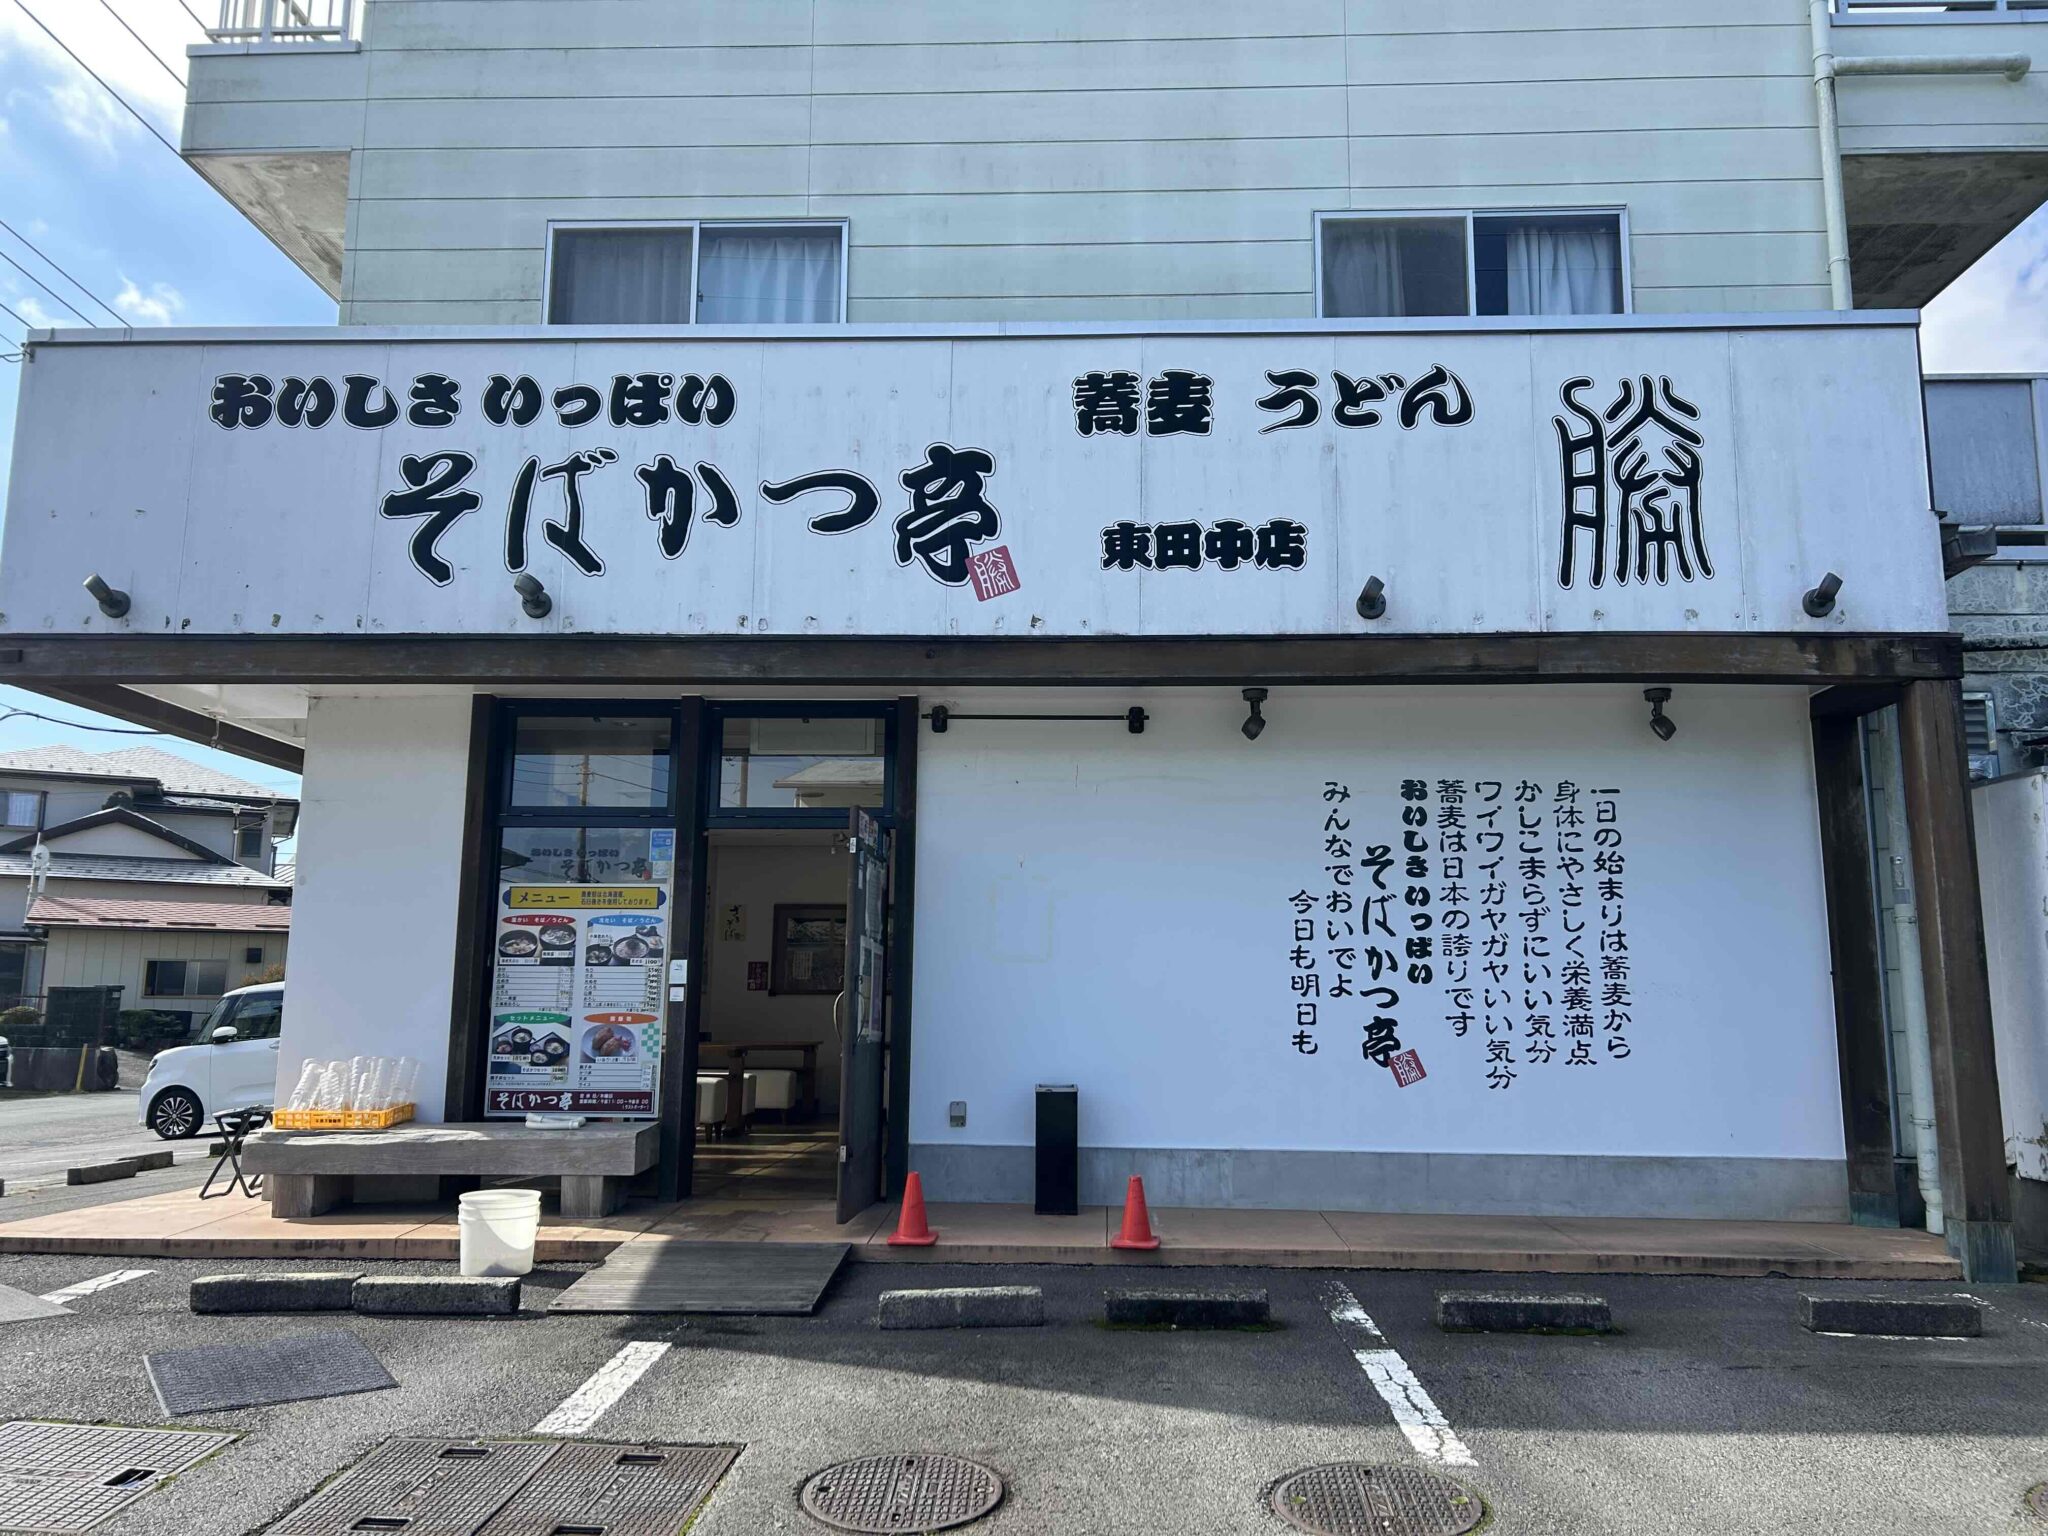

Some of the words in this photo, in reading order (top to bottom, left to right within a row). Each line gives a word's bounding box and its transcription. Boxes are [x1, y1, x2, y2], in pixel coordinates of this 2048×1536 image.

[1072, 369, 1216, 438] 蕎麦
[1256, 363, 1475, 435] うどん
[381, 441, 1002, 588] そばかつ亭
[1100, 518, 1310, 572] 東田中店
[519, 892, 570, 903] メニュー
[1288, 890, 1320, 1055] 今日も明日も
[1323, 781, 1357, 998] みんなでおいでよ
[1360, 844, 1401, 1068] そばかつ亭
[1401, 780, 1433, 984] おいしさいっぱい
[1436, 780, 1475, 1038] 蕎麦は日本の誇りです
[1475, 781, 1517, 1090] ワイワイガヤガヤいい気分
[1514, 780, 1557, 1063] かしこまらずにいい気分
[1553, 780, 1597, 1065] 身体にやさしく栄養満点
[1591, 787, 1631, 1059] 一日の始まりは蕎麦から
[496, 1092, 573, 1110] そばかつ亭
